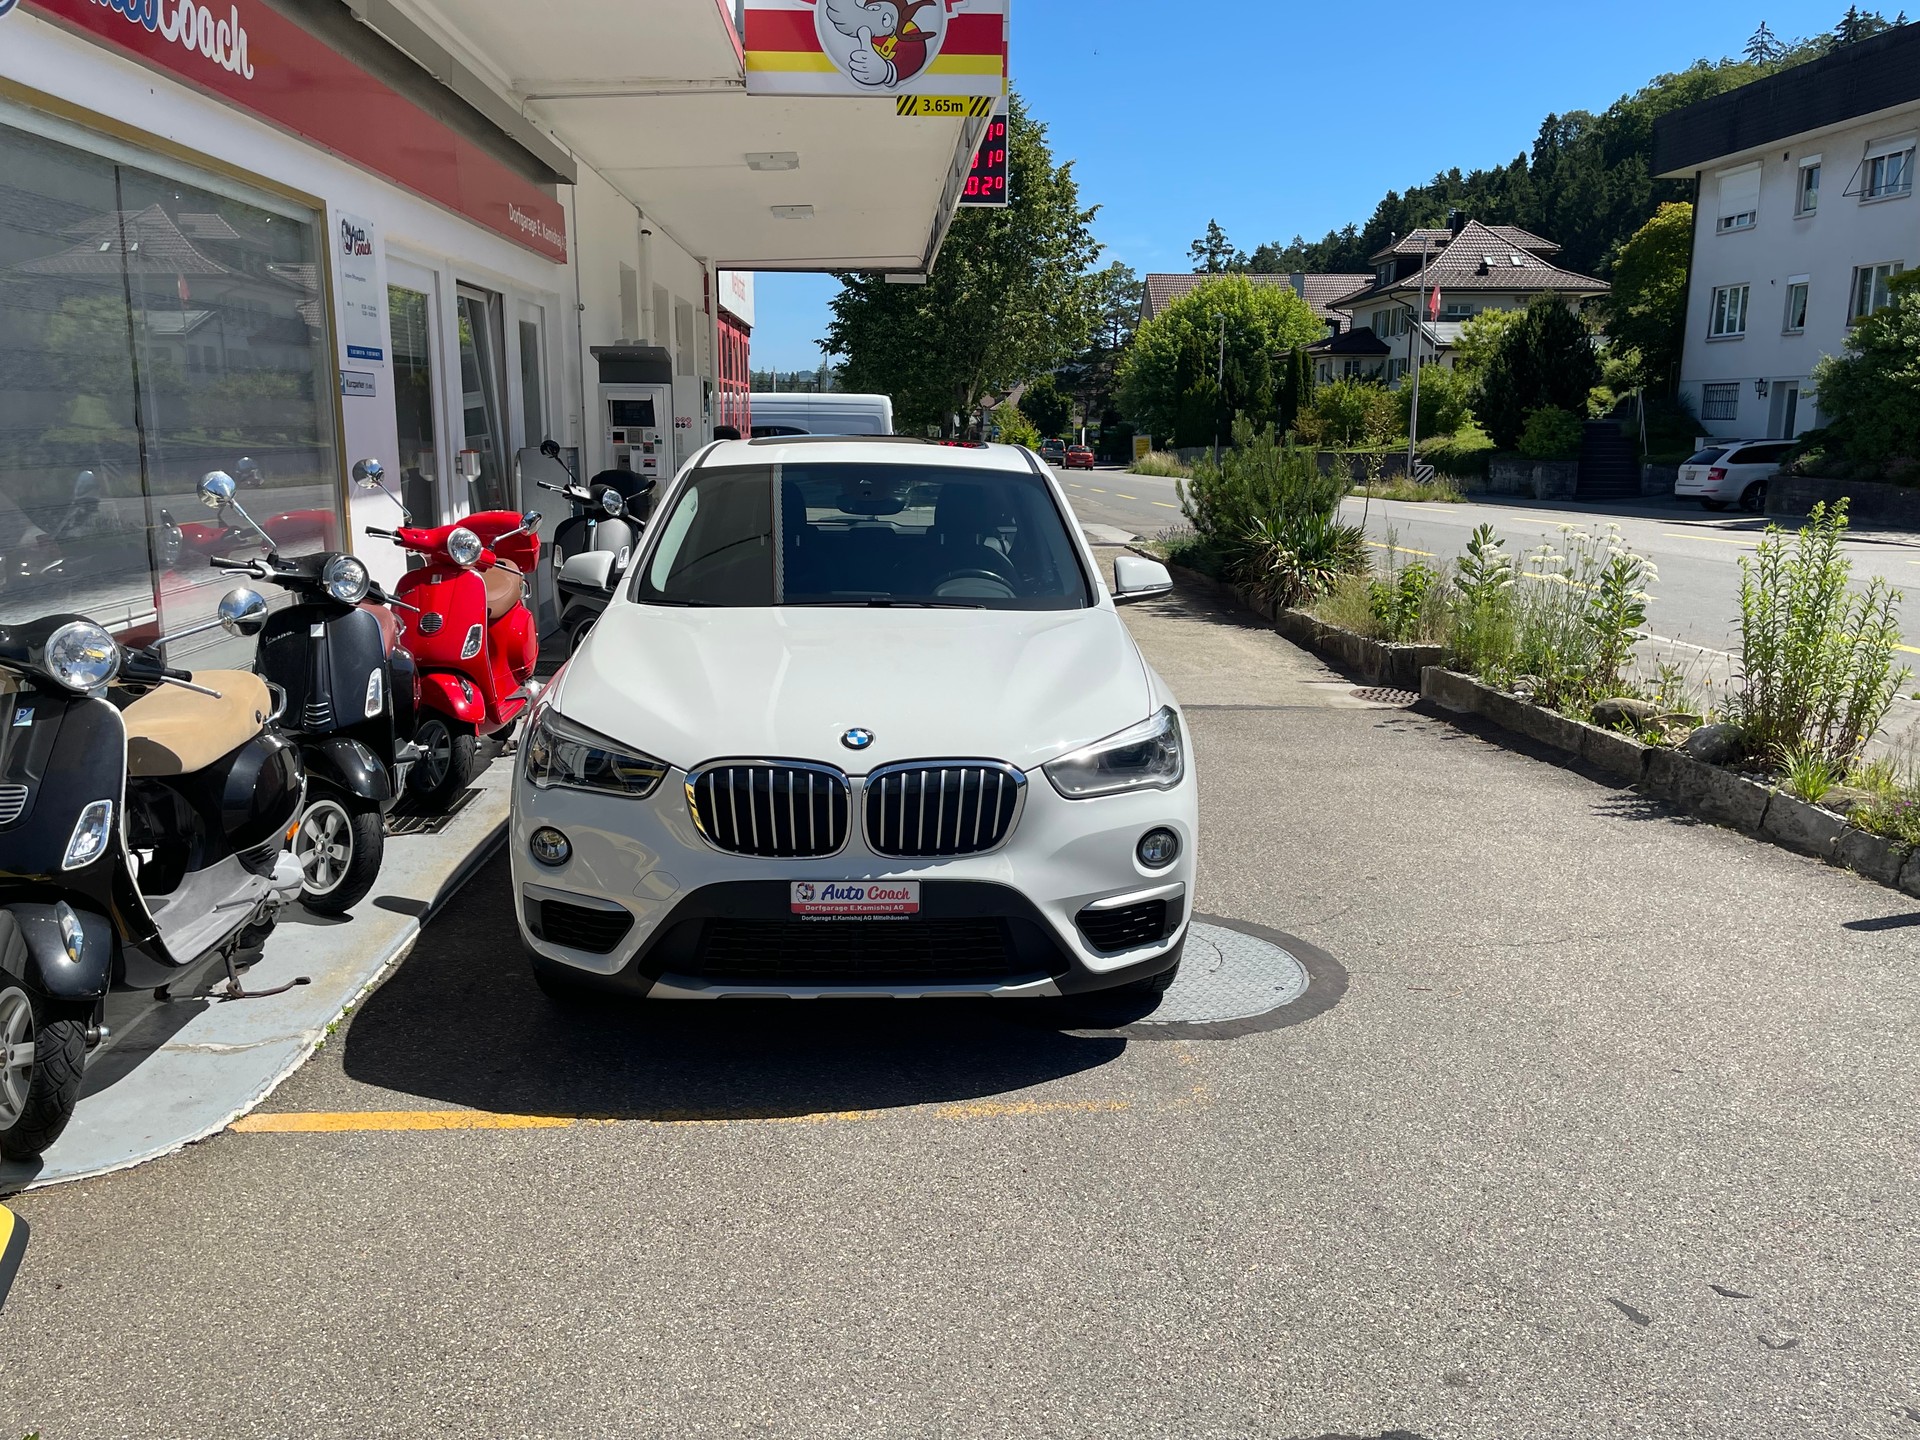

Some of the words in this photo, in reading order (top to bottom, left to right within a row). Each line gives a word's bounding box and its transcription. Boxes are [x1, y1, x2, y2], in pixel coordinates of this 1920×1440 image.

[923, 99, 963, 113] 3.65m
[821, 883, 865, 901] Auto
[867, 885, 911, 901] Coach
[805, 904, 849, 912] Dorfgarage
